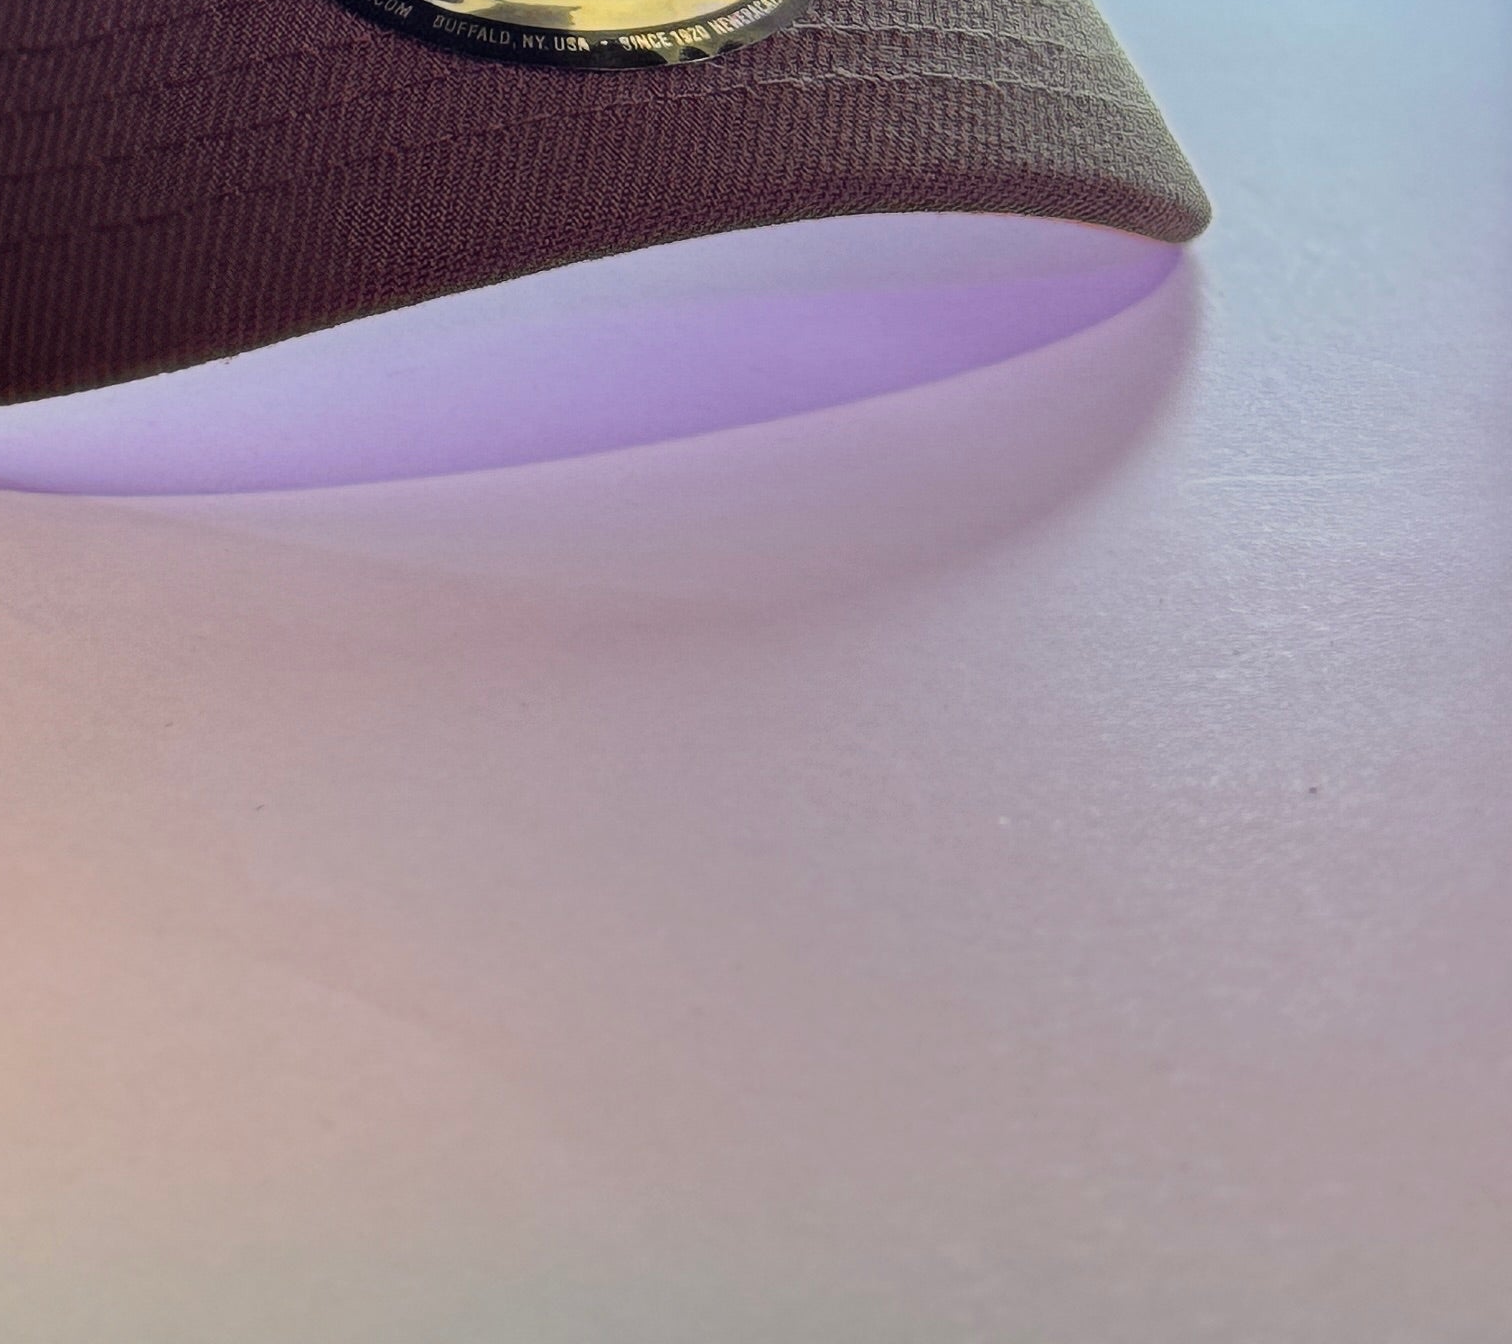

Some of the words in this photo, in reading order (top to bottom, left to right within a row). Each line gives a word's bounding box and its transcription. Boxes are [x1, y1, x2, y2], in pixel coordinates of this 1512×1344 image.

[553, 36, 591, 52] USA
[618, 30, 673, 52] SINCE
[669, 24, 711, 47] 1920
